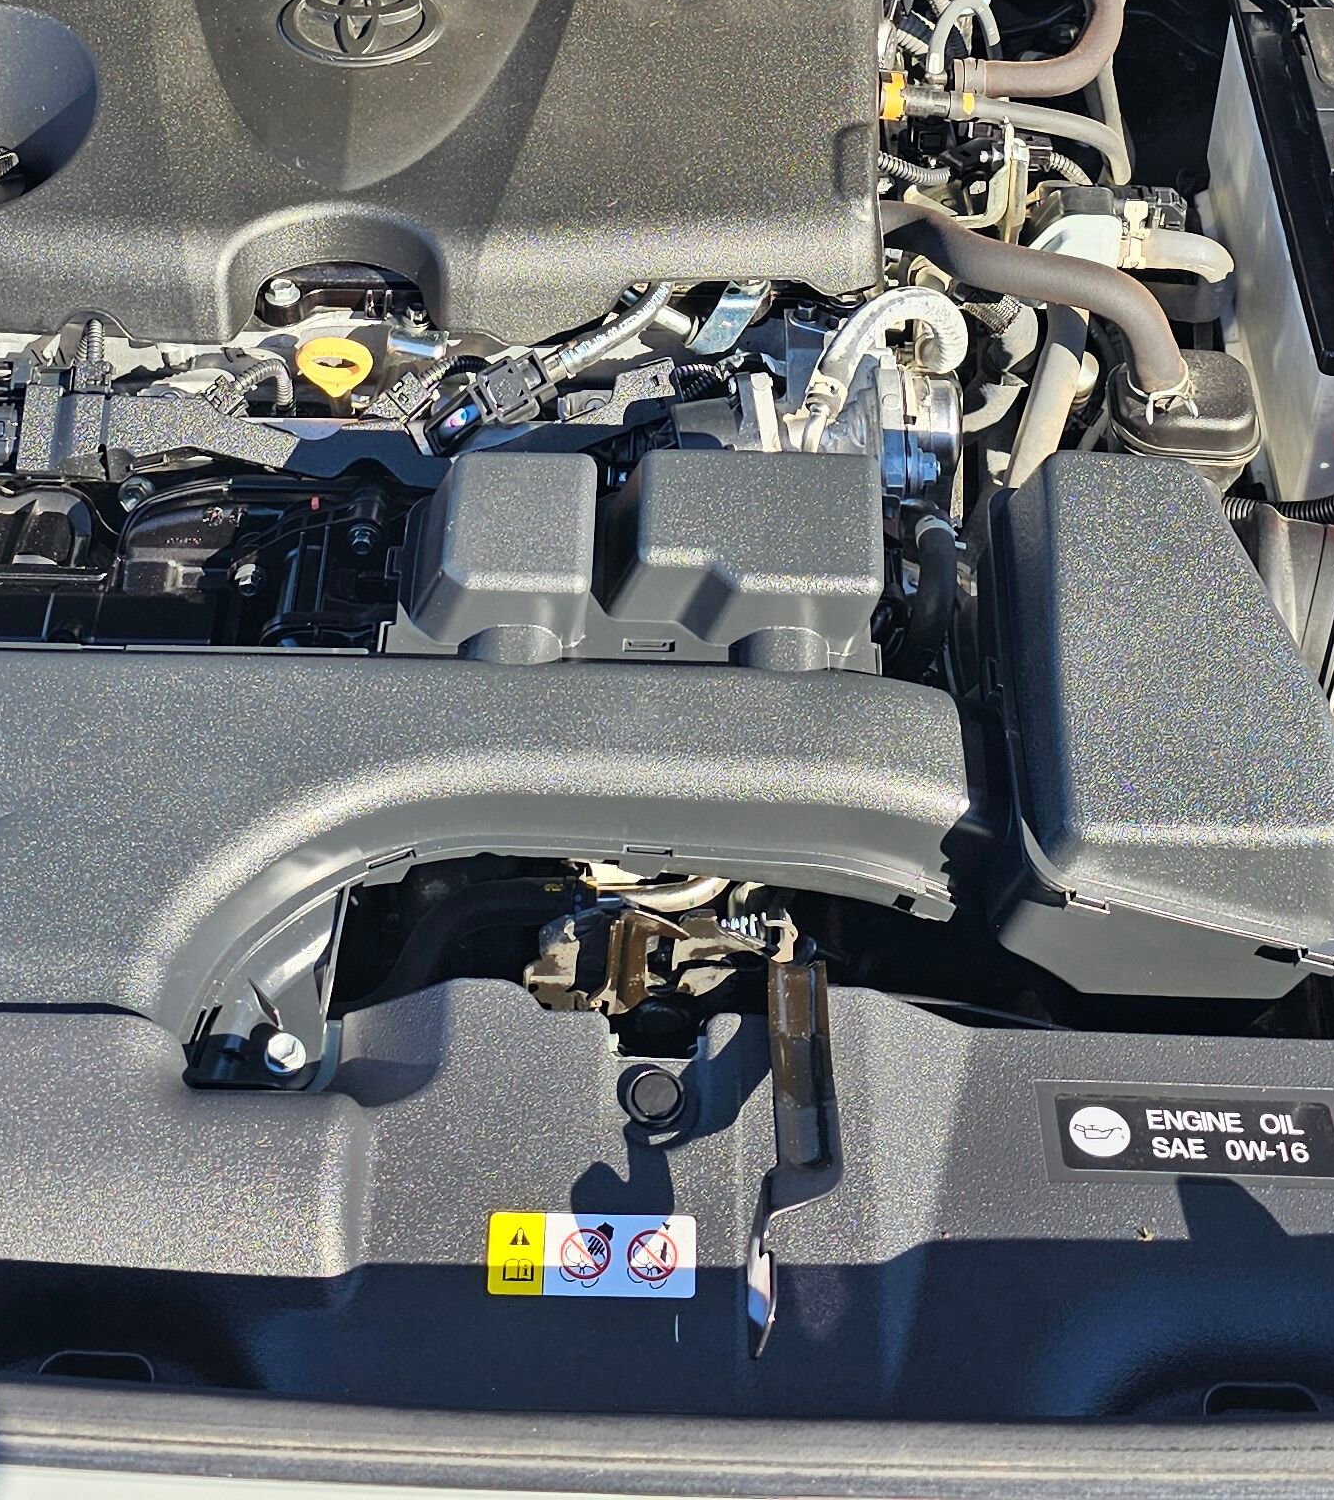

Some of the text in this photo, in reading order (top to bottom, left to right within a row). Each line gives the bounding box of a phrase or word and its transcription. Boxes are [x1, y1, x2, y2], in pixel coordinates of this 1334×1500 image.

[1145, 1108, 1305, 1136] ENGINE OIL
[1151, 1137, 1310, 1164] SAE 0W-16
